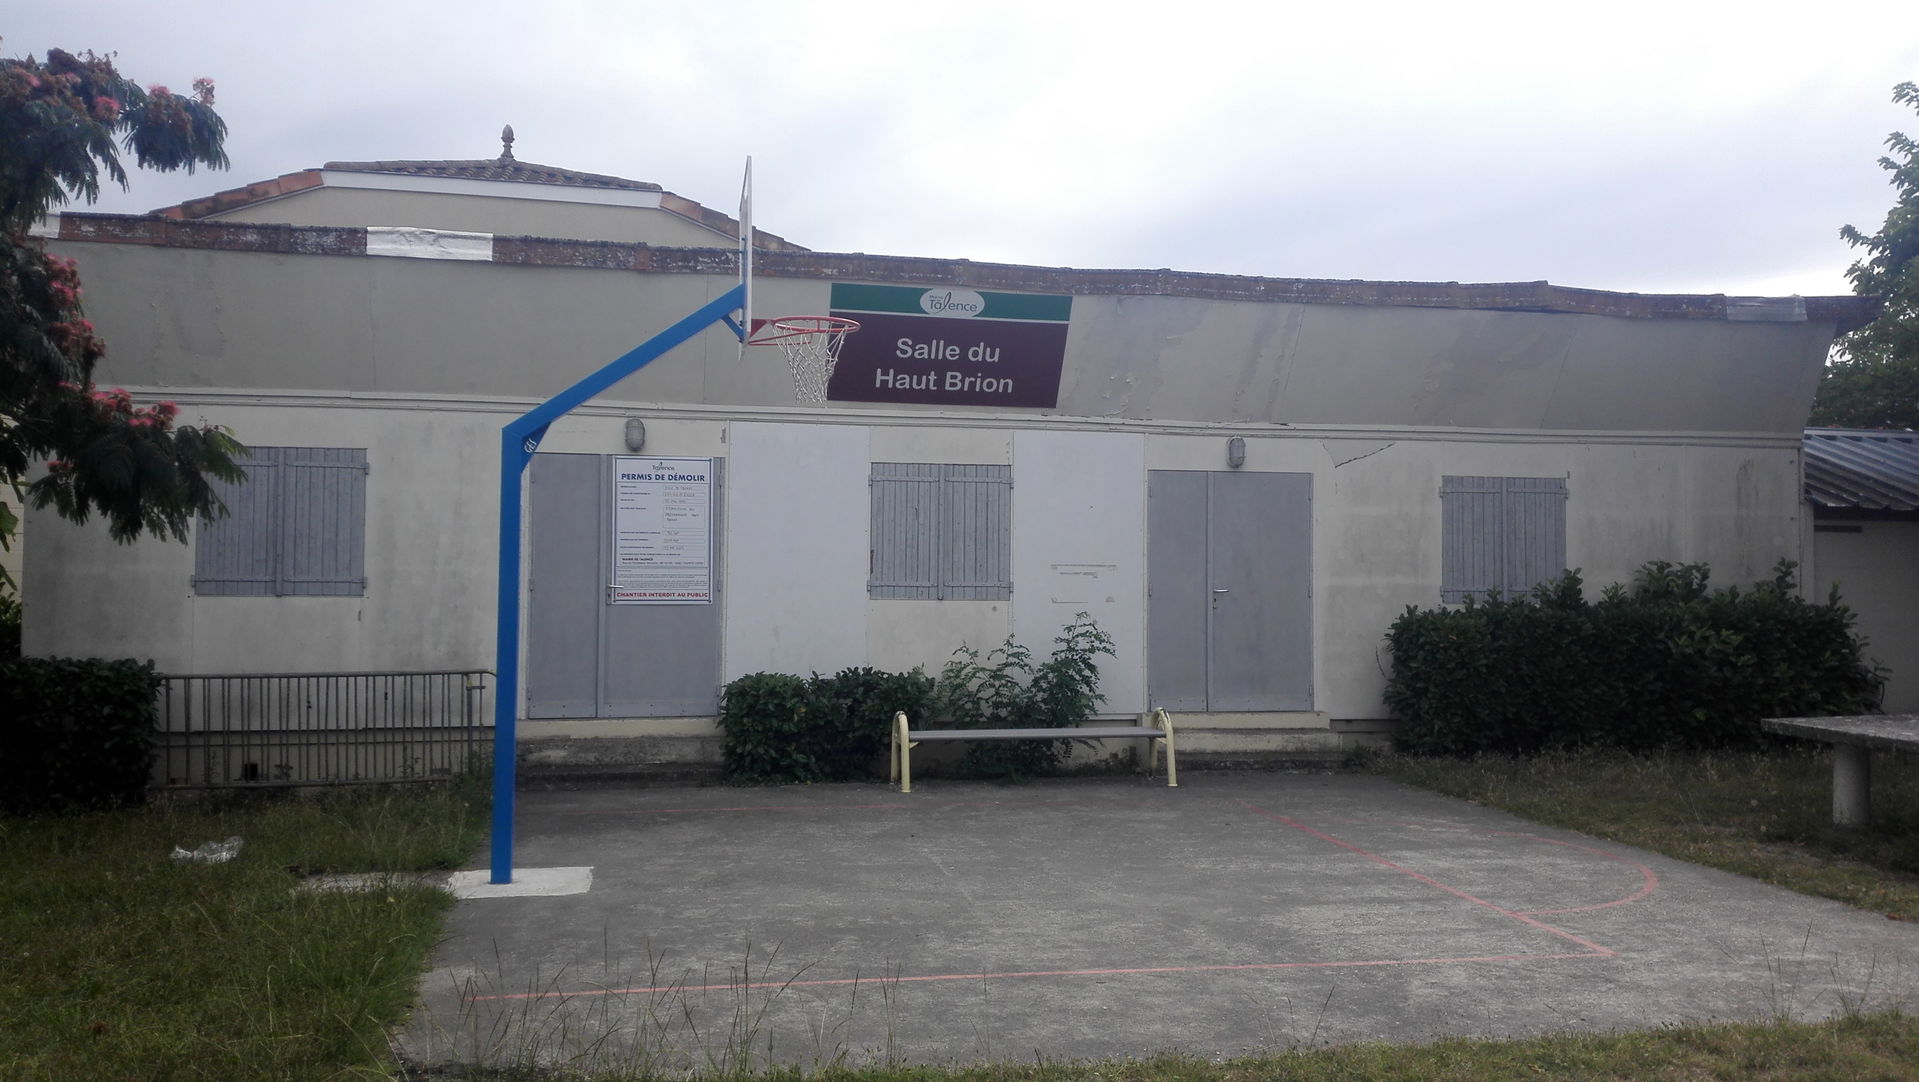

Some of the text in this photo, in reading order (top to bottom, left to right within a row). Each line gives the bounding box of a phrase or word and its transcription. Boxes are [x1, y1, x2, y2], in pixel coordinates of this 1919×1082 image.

[929, 291, 977, 313] Talence
[896, 337, 1000, 363] Salle du
[875, 368, 1013, 393] Haut Brion
[621, 472, 705, 482] PERMIS DE DÉMOLIR
